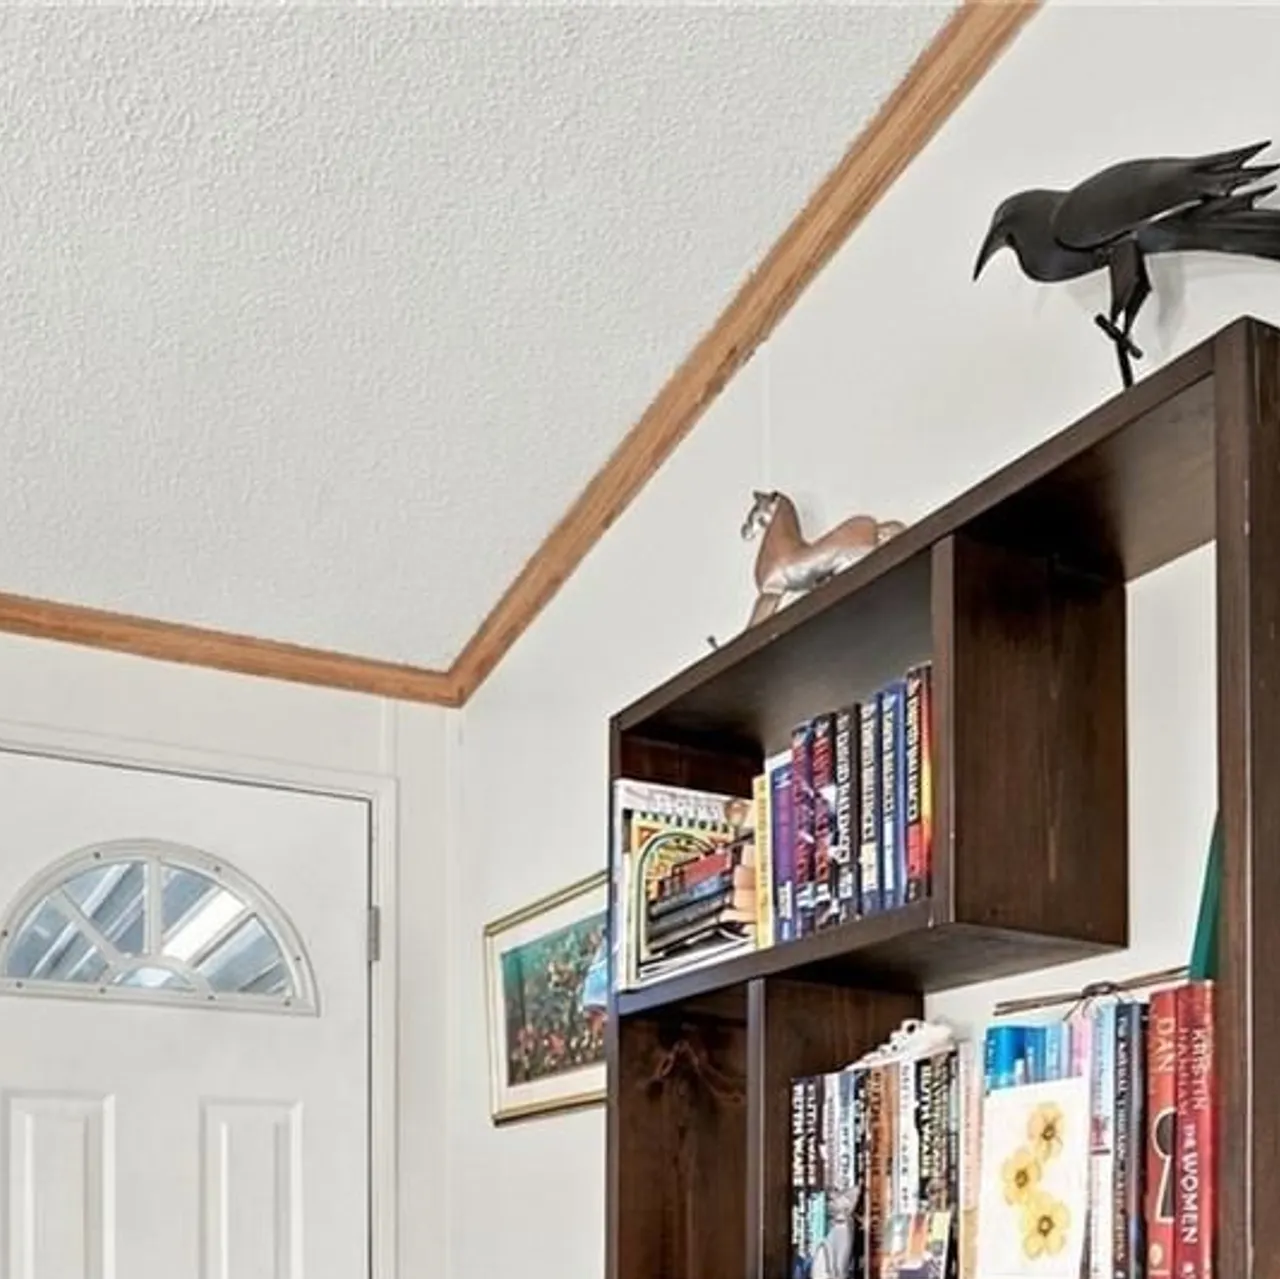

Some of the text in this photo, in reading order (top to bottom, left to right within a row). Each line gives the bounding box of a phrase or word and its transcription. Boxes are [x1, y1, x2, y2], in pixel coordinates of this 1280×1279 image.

[1159, 1017, 1175, 1071] DAN
[1193, 1028, 1212, 1109] KRISTIN
[1181, 1151, 1198, 1243] WOMEN
